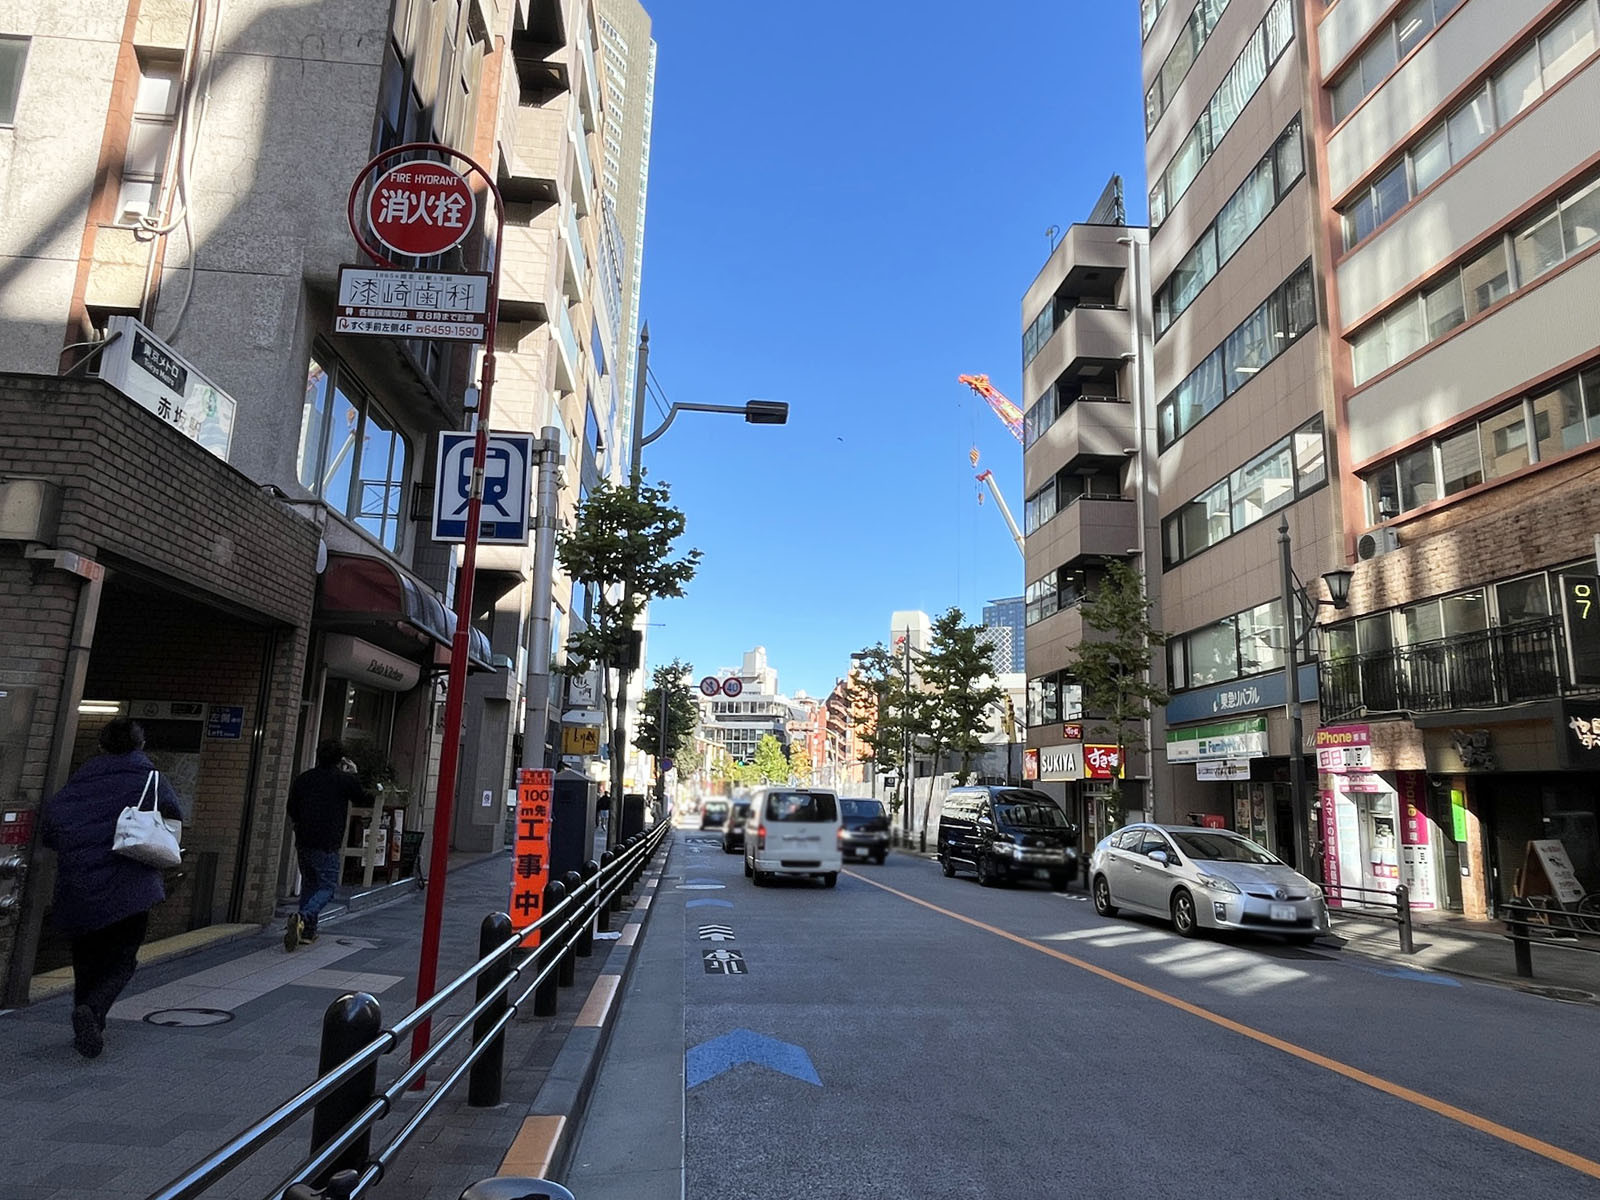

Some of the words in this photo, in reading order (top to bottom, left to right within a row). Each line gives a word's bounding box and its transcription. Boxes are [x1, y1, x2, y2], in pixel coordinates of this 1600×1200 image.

[390, 172, 412, 184] FIRE
[414, 174, 459, 187] HYDRANT
[378, 188, 466, 228] 消火栓
[350, 278, 474, 310] 漆崎歯科
[351, 321, 413, 333] すぐ手前左側4F
[143, 342, 179, 379] 東京メトロ
[726, 681, 739, 693] 40
[1220, 687, 1260, 710] 東急リバブル
[1316, 732, 1352, 745] iPhone
[1041, 753, 1076, 773] SUKIYA
[523, 789, 550, 802] 100
[521, 805, 547, 817] m先
[514, 818, 544, 917] 工事中
